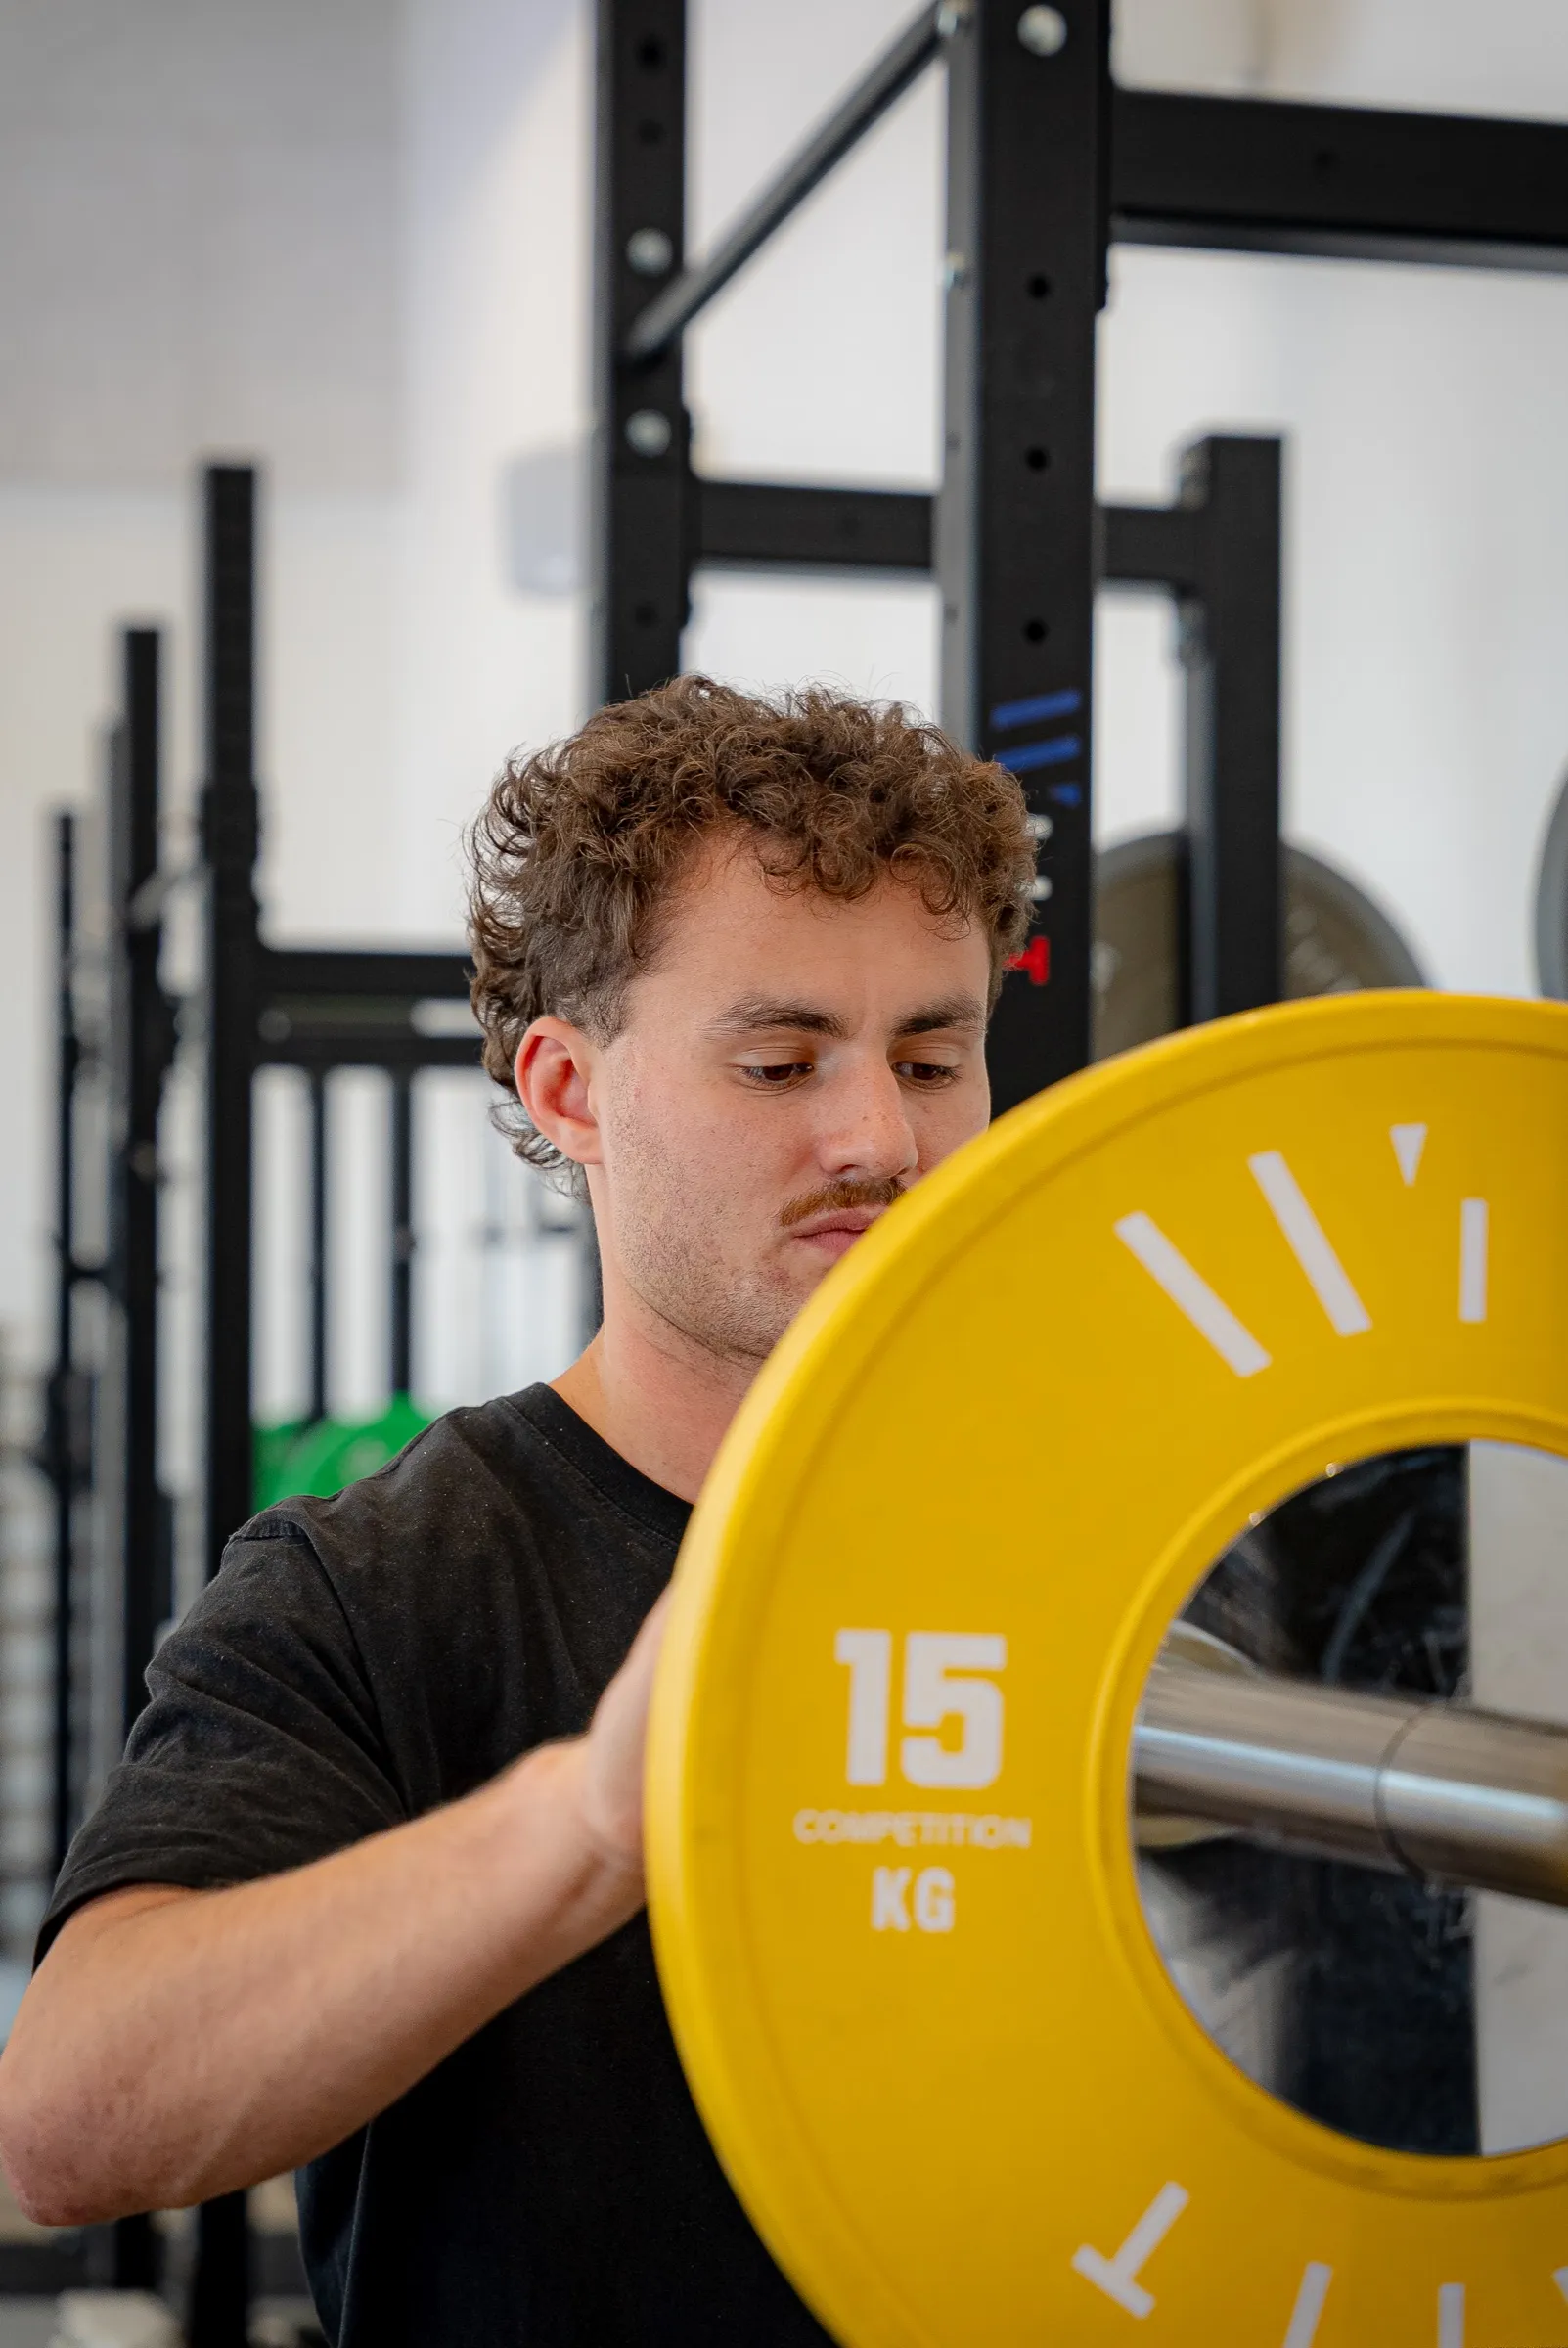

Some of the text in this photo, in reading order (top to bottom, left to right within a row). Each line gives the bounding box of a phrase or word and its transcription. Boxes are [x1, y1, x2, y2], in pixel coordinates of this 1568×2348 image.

[834, 1628, 1007, 1790] 15
[793, 1809, 1031, 1848] COMPETITION
[872, 1867, 955, 1932] KG
